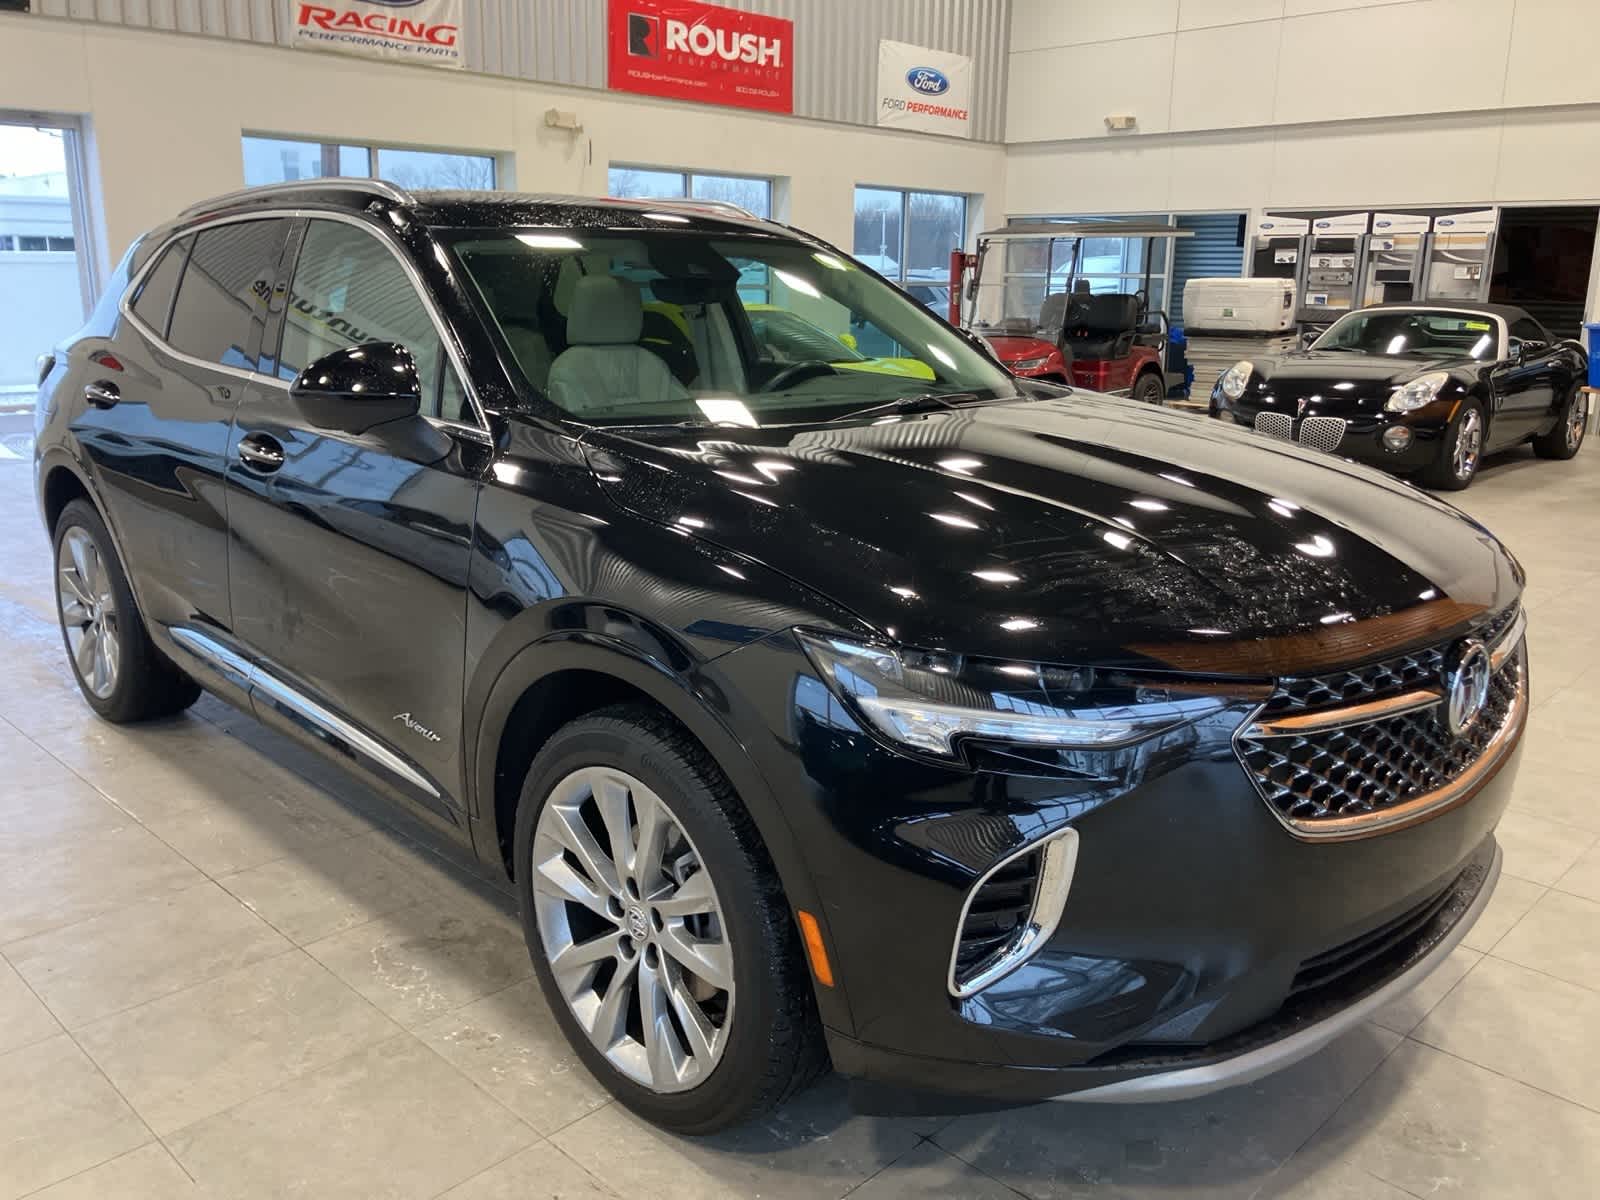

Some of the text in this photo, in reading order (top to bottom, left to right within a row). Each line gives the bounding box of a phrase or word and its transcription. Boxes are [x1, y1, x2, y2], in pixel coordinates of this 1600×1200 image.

[298, 5, 458, 46] RACING
[298, 29, 458, 57] PERFORMANCE PARTS
[666, 19, 782, 68] ROUSH
[667, 53, 780, 80] PERFORMANCE
[914, 70, 941, 92] Ford
[882, 98, 968, 120] FORD PERFORMANCE
[392, 712, 441, 742] Avenir
